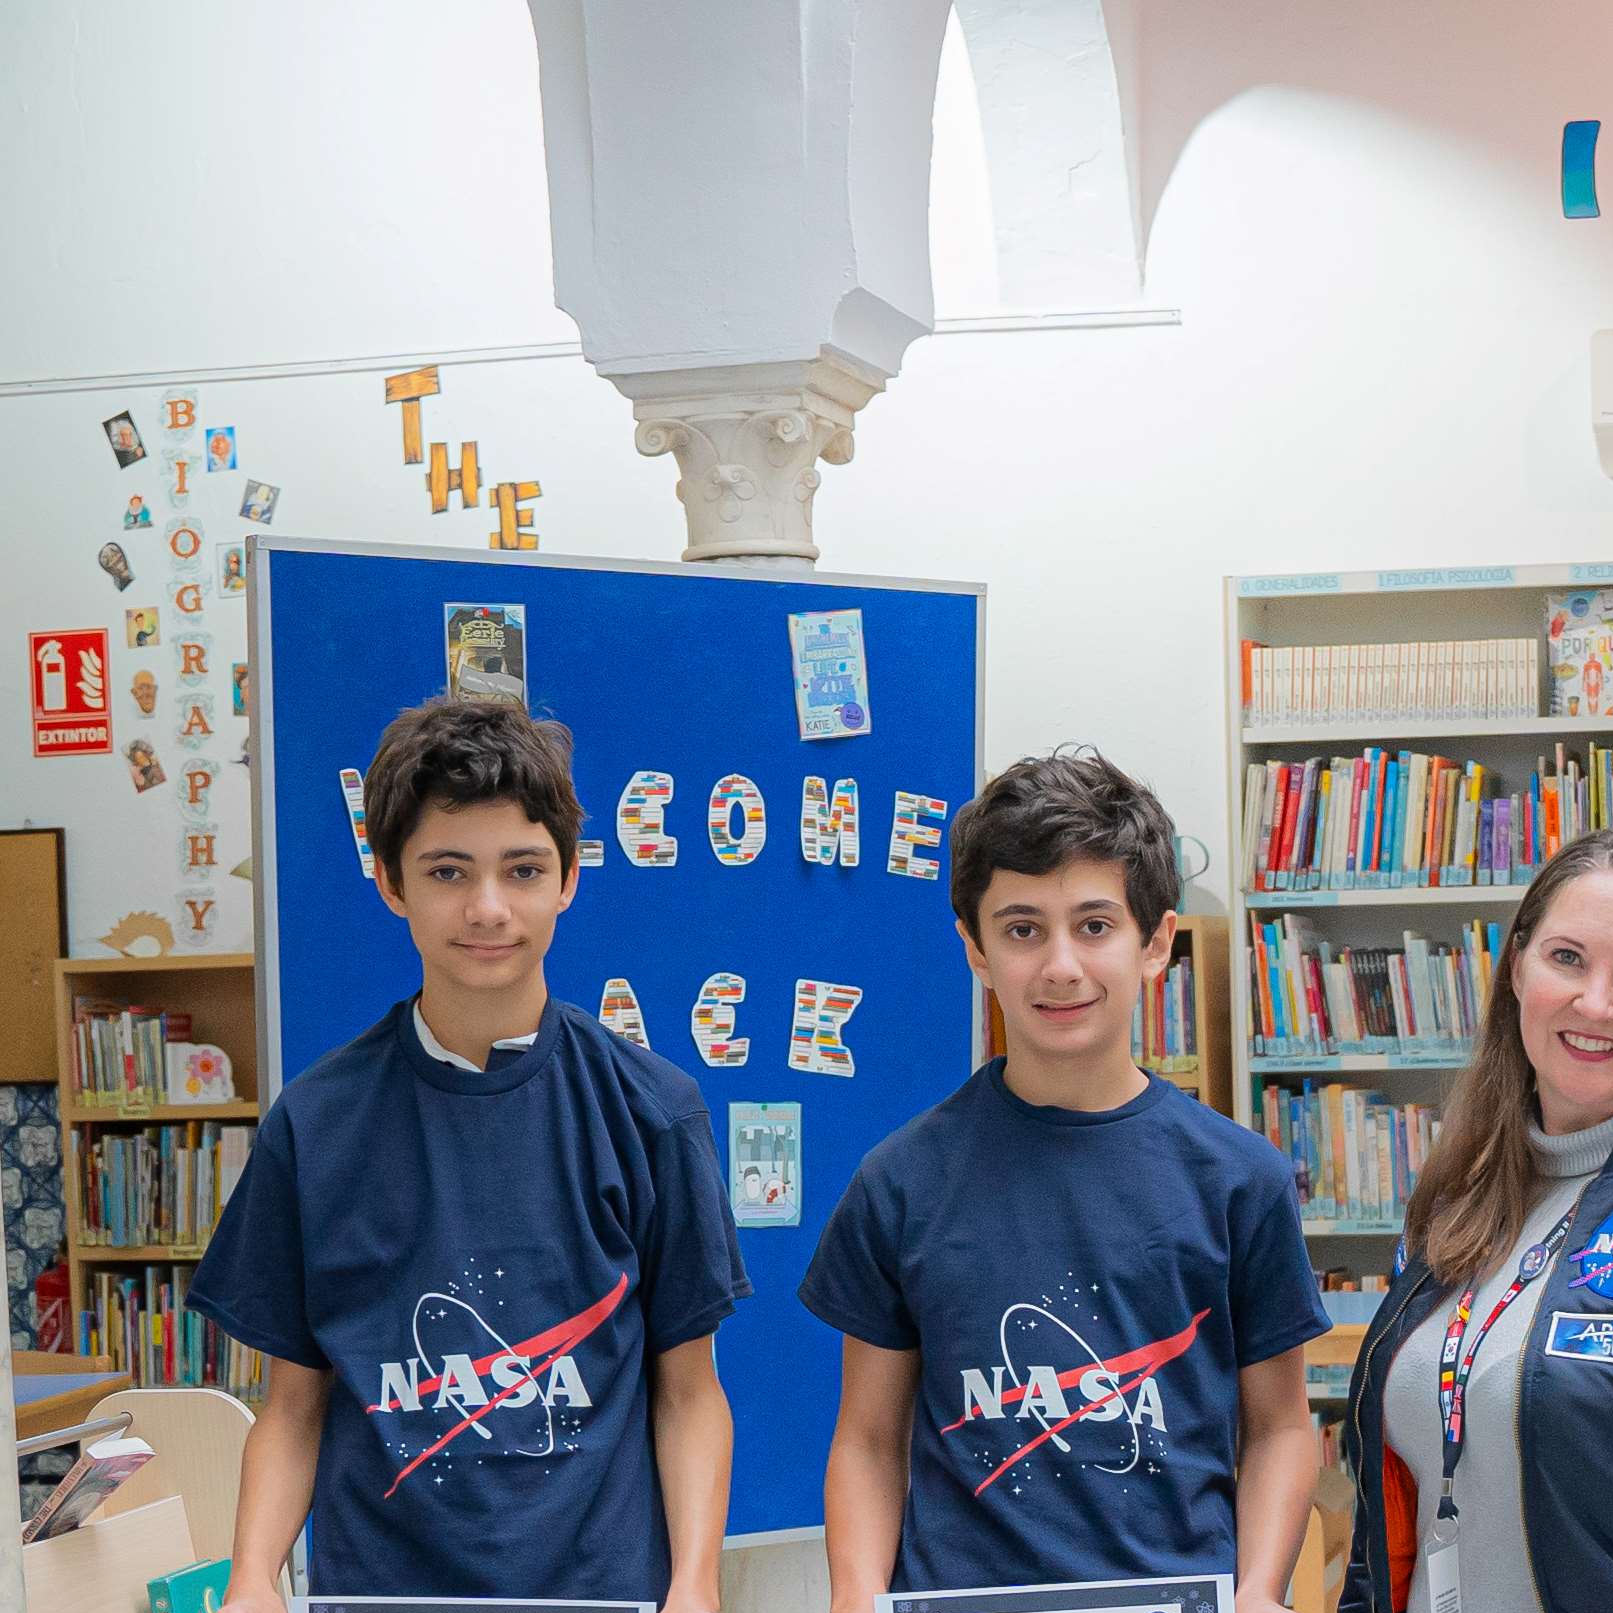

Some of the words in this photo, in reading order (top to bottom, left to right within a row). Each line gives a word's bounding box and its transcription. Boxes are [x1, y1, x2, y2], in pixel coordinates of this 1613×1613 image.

[385, 364, 542, 550] THE
[1254, 575, 1338, 593] GENERALIDADES
[163, 395, 219, 932] BIOGRAPHY
[38, 727, 107, 746] EXTINTOR
[598, 971, 863, 1079] ACK
[379, 1353, 593, 1413] NASA
[960, 1365, 1168, 1433] NASA
